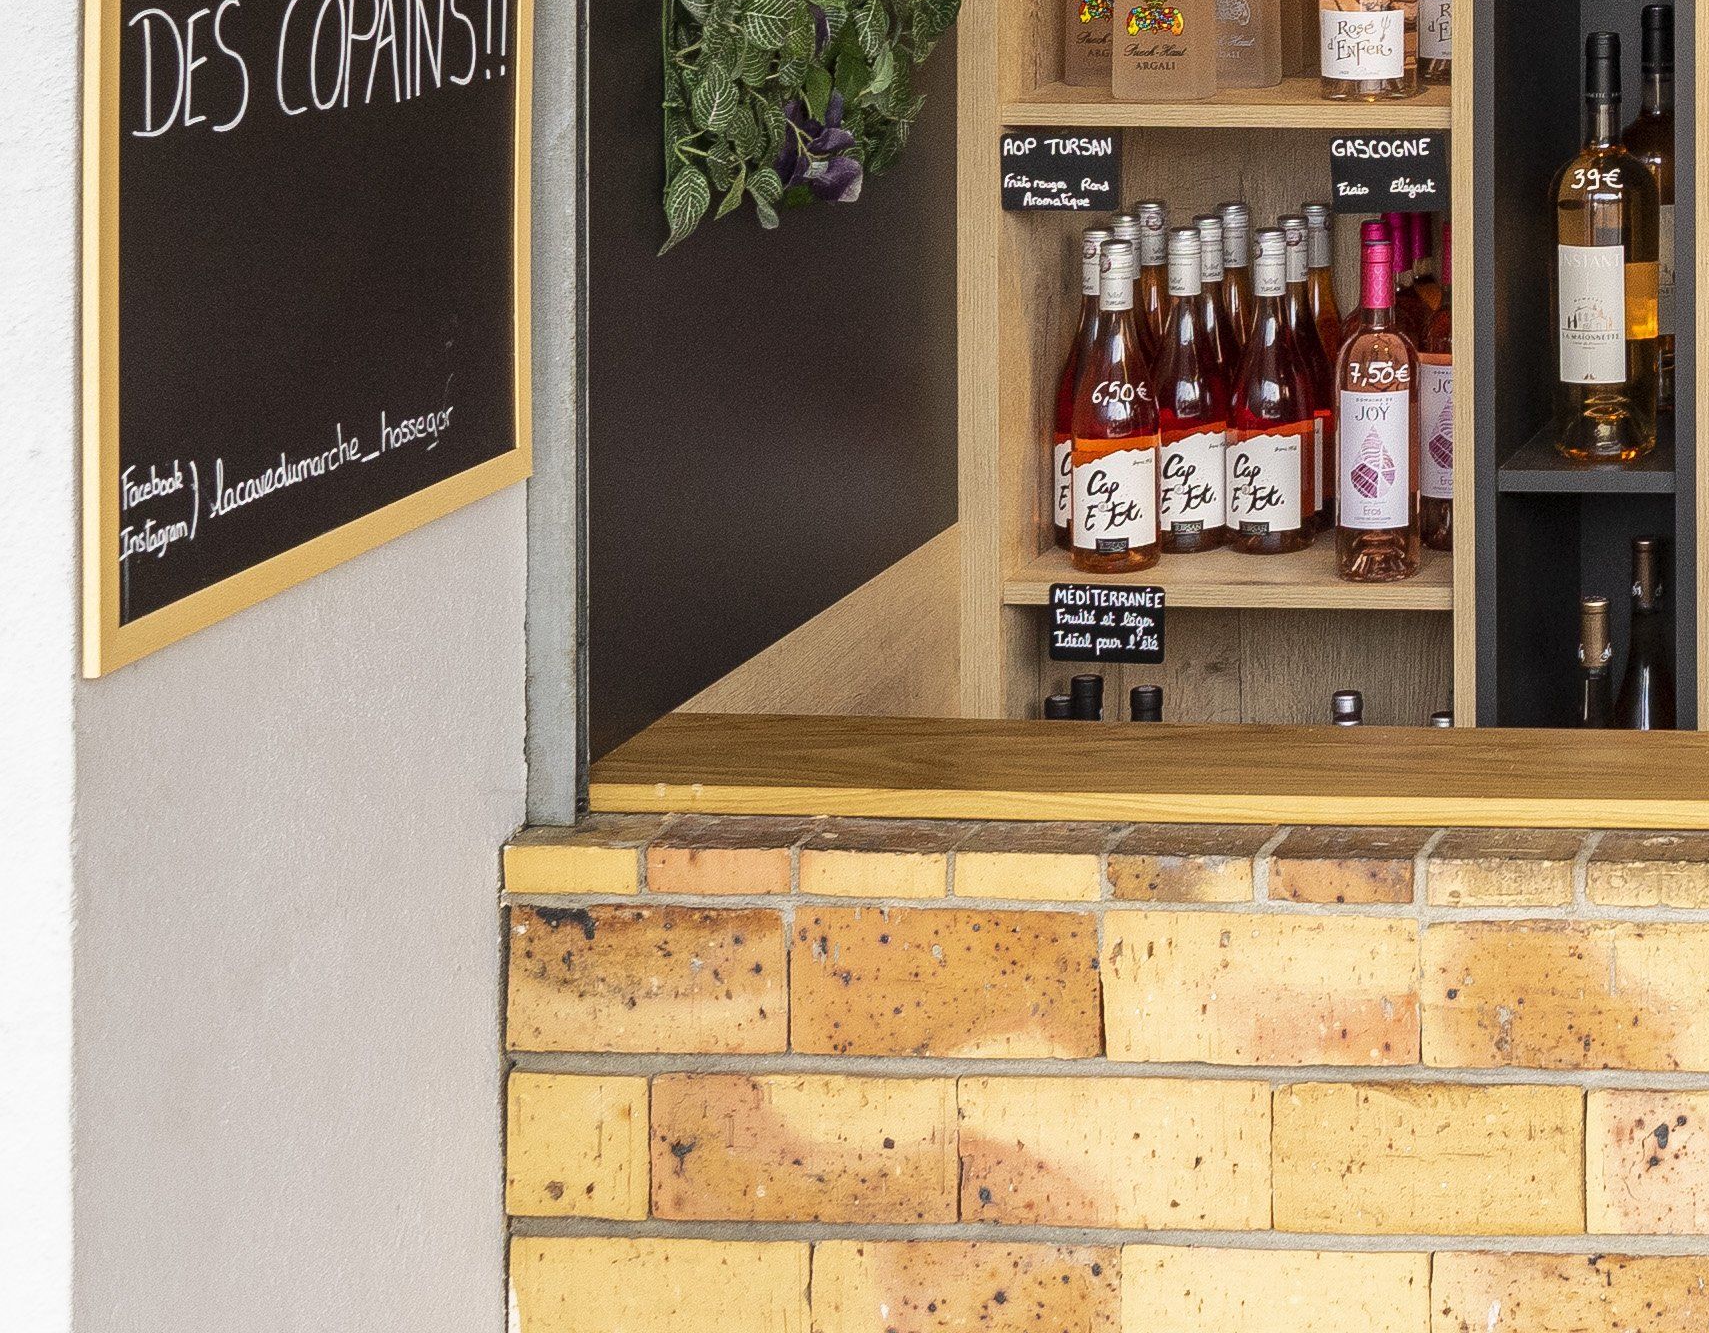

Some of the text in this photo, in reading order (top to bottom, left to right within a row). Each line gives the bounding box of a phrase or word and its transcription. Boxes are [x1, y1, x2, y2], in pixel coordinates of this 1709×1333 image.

[1338, 19, 1375, 39] Rosé
[1135, 62, 1176, 71] ARGALI
[1003, 136, 1112, 157] AOP TURSAN
[1331, 137, 1431, 159] GASCOGNE
[1080, 177, 1110, 192] Rond
[1570, 168, 1624, 192] 39€
[1349, 361, 1411, 385] 7,50€
[1091, 380, 1153, 407] 6,50€
[1162, 452, 1197, 485] Cap
[121, 459, 184, 510] Facebook
[1086, 469, 1120, 503] Cap
[118, 519, 189, 562] Instagram
[1055, 607, 1097, 626] Fruité
[1099, 611, 1116, 627] et
[1053, 629, 1123, 656] Idéal pour
